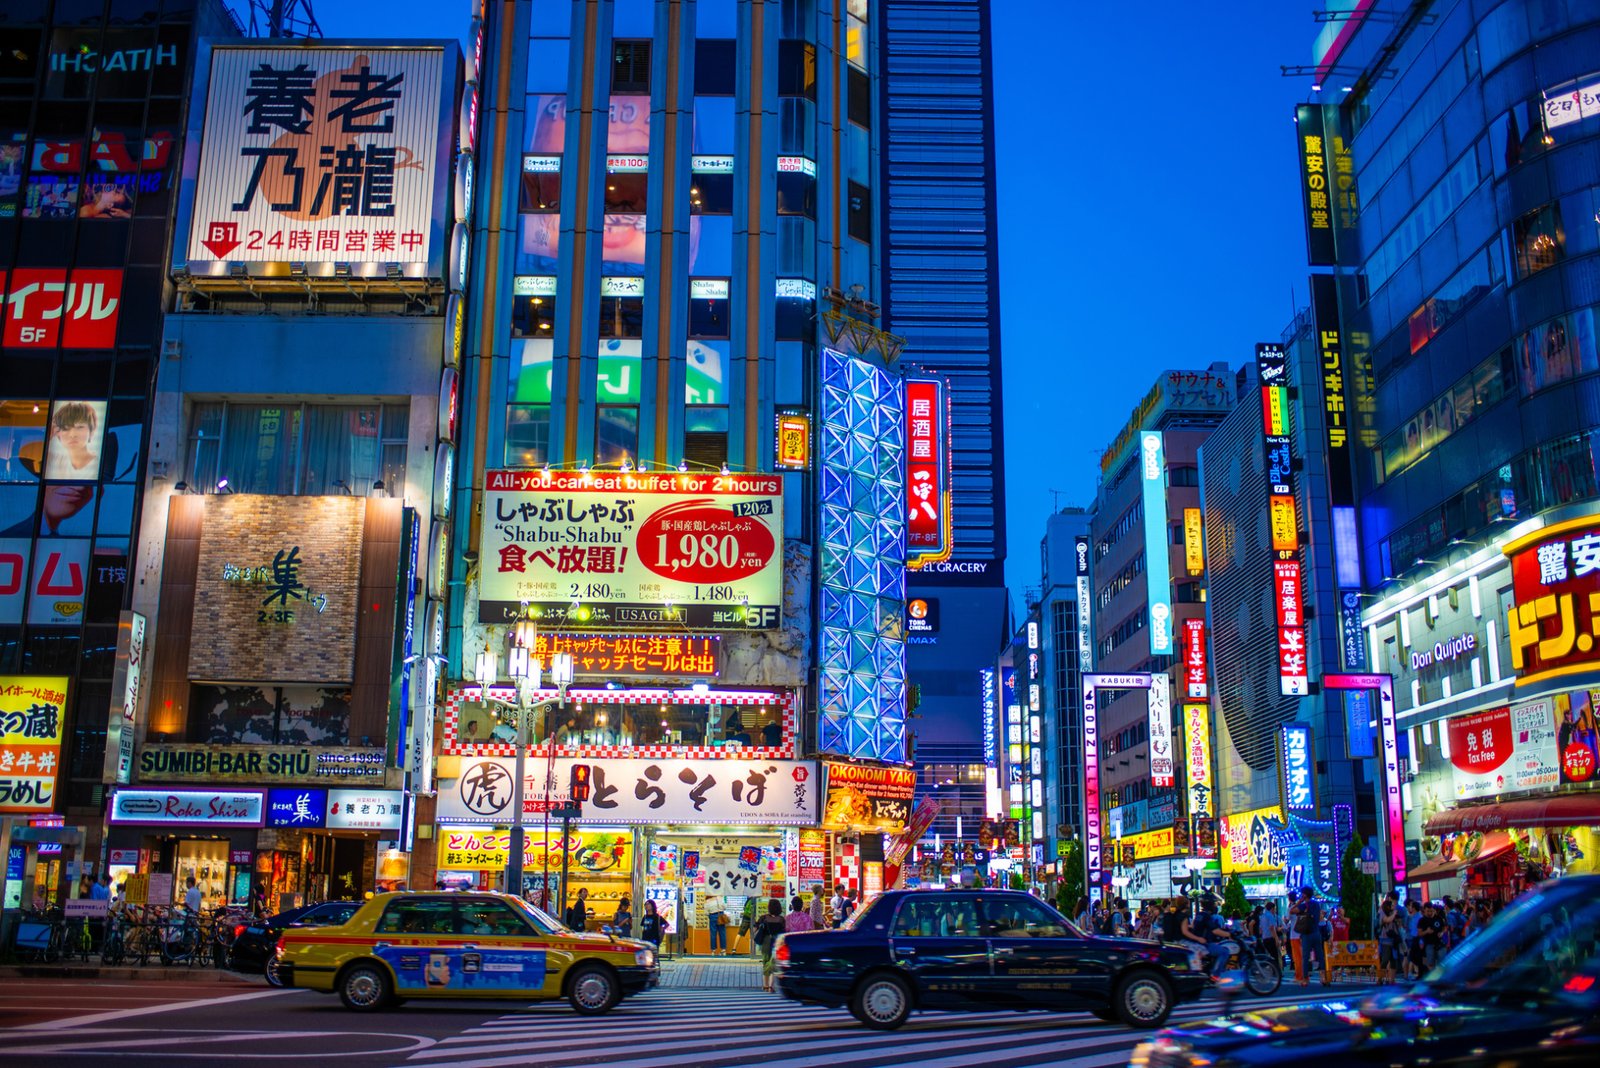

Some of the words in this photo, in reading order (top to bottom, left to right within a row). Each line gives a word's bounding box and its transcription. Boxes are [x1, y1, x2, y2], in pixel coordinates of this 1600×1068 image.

[243, 63, 404, 135] 養老
[231, 143, 397, 217] 乃瀧
[1304, 135, 1329, 229] 驚安の殿堂
[211, 226, 235, 243] B1
[246, 229, 425, 252] 24時間営業中
[20, 327, 47, 342] 5F
[911, 399, 931, 458] 居酒屋
[492, 474, 622, 490] All-you-can-eat
[627, 476, 676, 491] buffet
[681, 477, 707, 491] for
[712, 477, 724, 491] 2
[728, 478, 777, 492] hours
[908, 470, 937, 520] つぼ八
[496, 498, 635, 523] しゃぶしゃぶ
[735, 502, 770, 516] 120分
[498, 544, 628, 574] 食べ放題!
[654, 533, 739, 573] 1,980
[740, 558, 762, 569] yen
[1279, 550, 1293, 560] 6F
[936, 562, 987, 573] GRACERY
[570, 582, 610, 599] 2,480
[610, 591, 626, 600] yen
[694, 585, 733, 602] 1,480
[733, 593, 749, 602] yen
[1281, 580, 1298, 625] 居楽屋
[907, 636, 937, 644] IMAX
[1411, 650, 1432, 670] Don
[1433, 632, 1476, 661] Quijote
[121, 739, 132, 749] TAX
[1085, 703, 1099, 798] GODZILLA
[1466, 727, 1494, 752] 免税
[141, 750, 262, 774] SUMIBI-BAR
[267, 748, 310, 775] SHŪ
[316, 753, 350, 764] since
[1289, 729, 1311, 804] カラオケ
[1468, 753, 1480, 765] Tax
[1480, 751, 1495, 762] Free
[466, 761, 506, 810] 虎
[830, 764, 887, 782] OKONOMI
[889, 770, 916, 785] YAKI
[1154, 777, 1170, 786] B1
[592, 764, 778, 812] とらそば
[165, 795, 203, 818] Roko
[207, 796, 249, 819] Shira
[1088, 807, 1099, 853] ROAD
[1461, 816, 1474, 828] Don
[1476, 814, 1501, 829] Quijote
[1318, 843, 1333, 892] カラオケ
